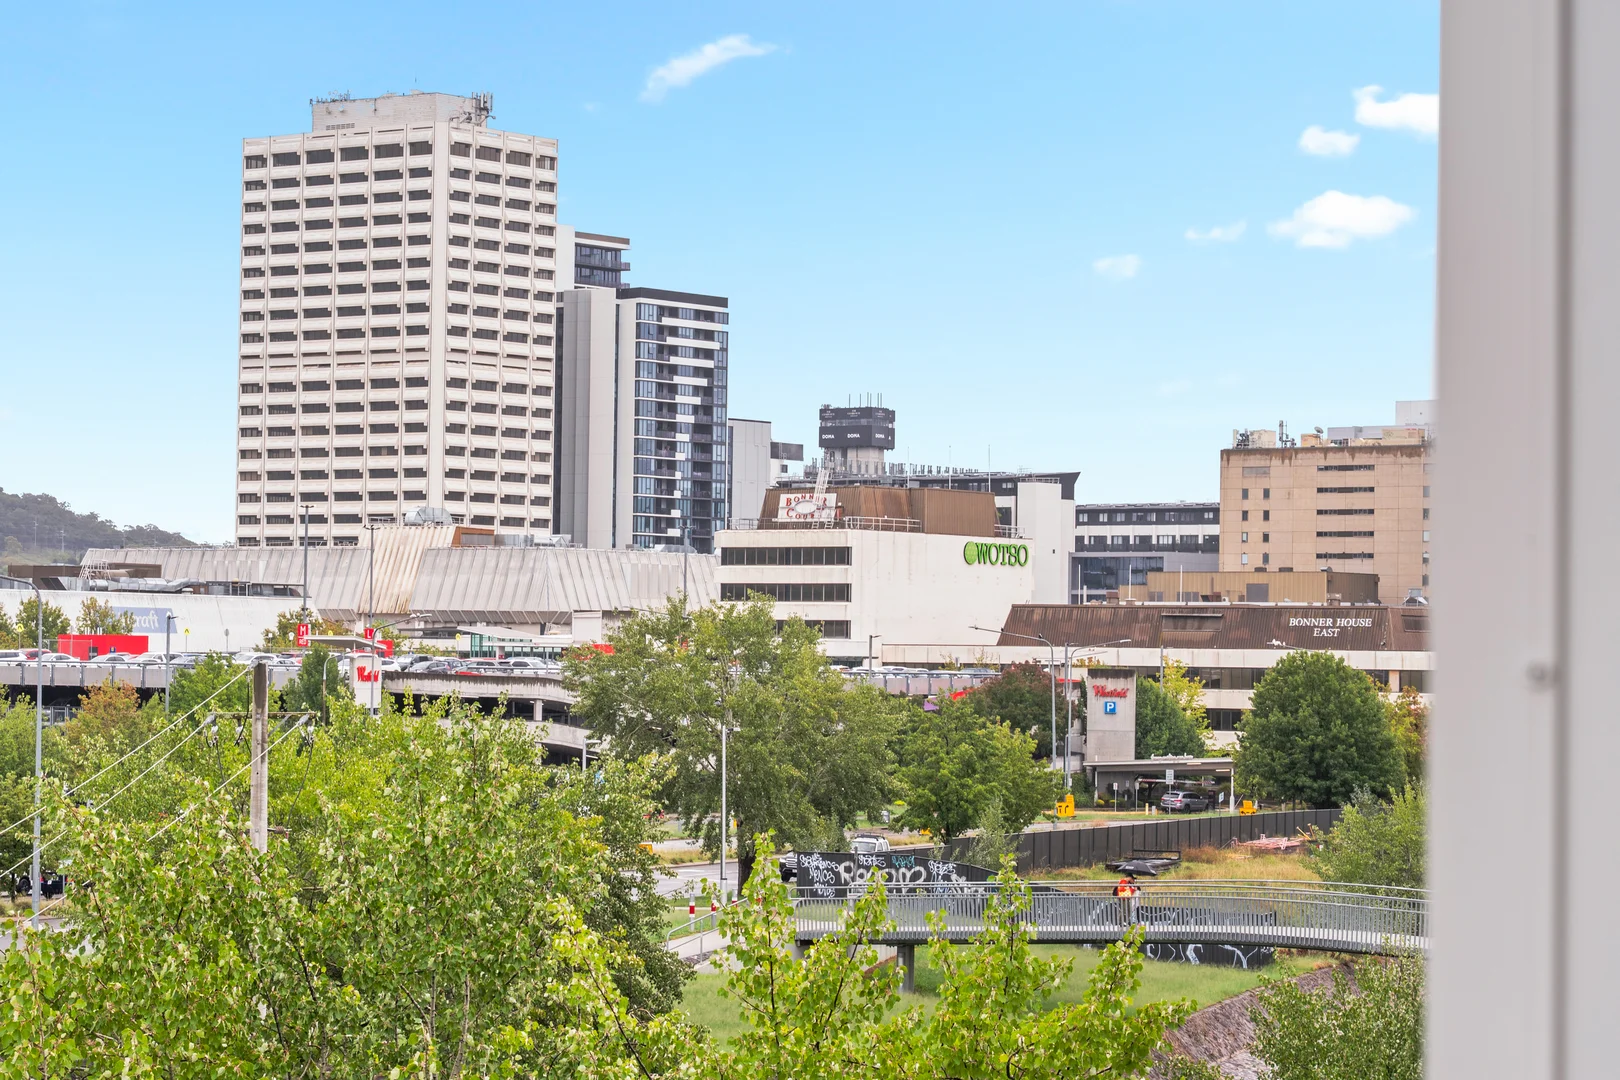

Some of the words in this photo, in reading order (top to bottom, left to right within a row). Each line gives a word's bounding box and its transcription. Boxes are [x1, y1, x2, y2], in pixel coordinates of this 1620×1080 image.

[786, 493, 827, 507] BONNR
[975, 542, 1029, 567] WOTSO
[1289, 618, 1333, 627] BONNER
[1336, 618, 1373, 627] HOUSE
[299, 625, 307, 636] M
[1313, 628, 1340, 637] EAST
[1106, 702, 1115, 712] P
